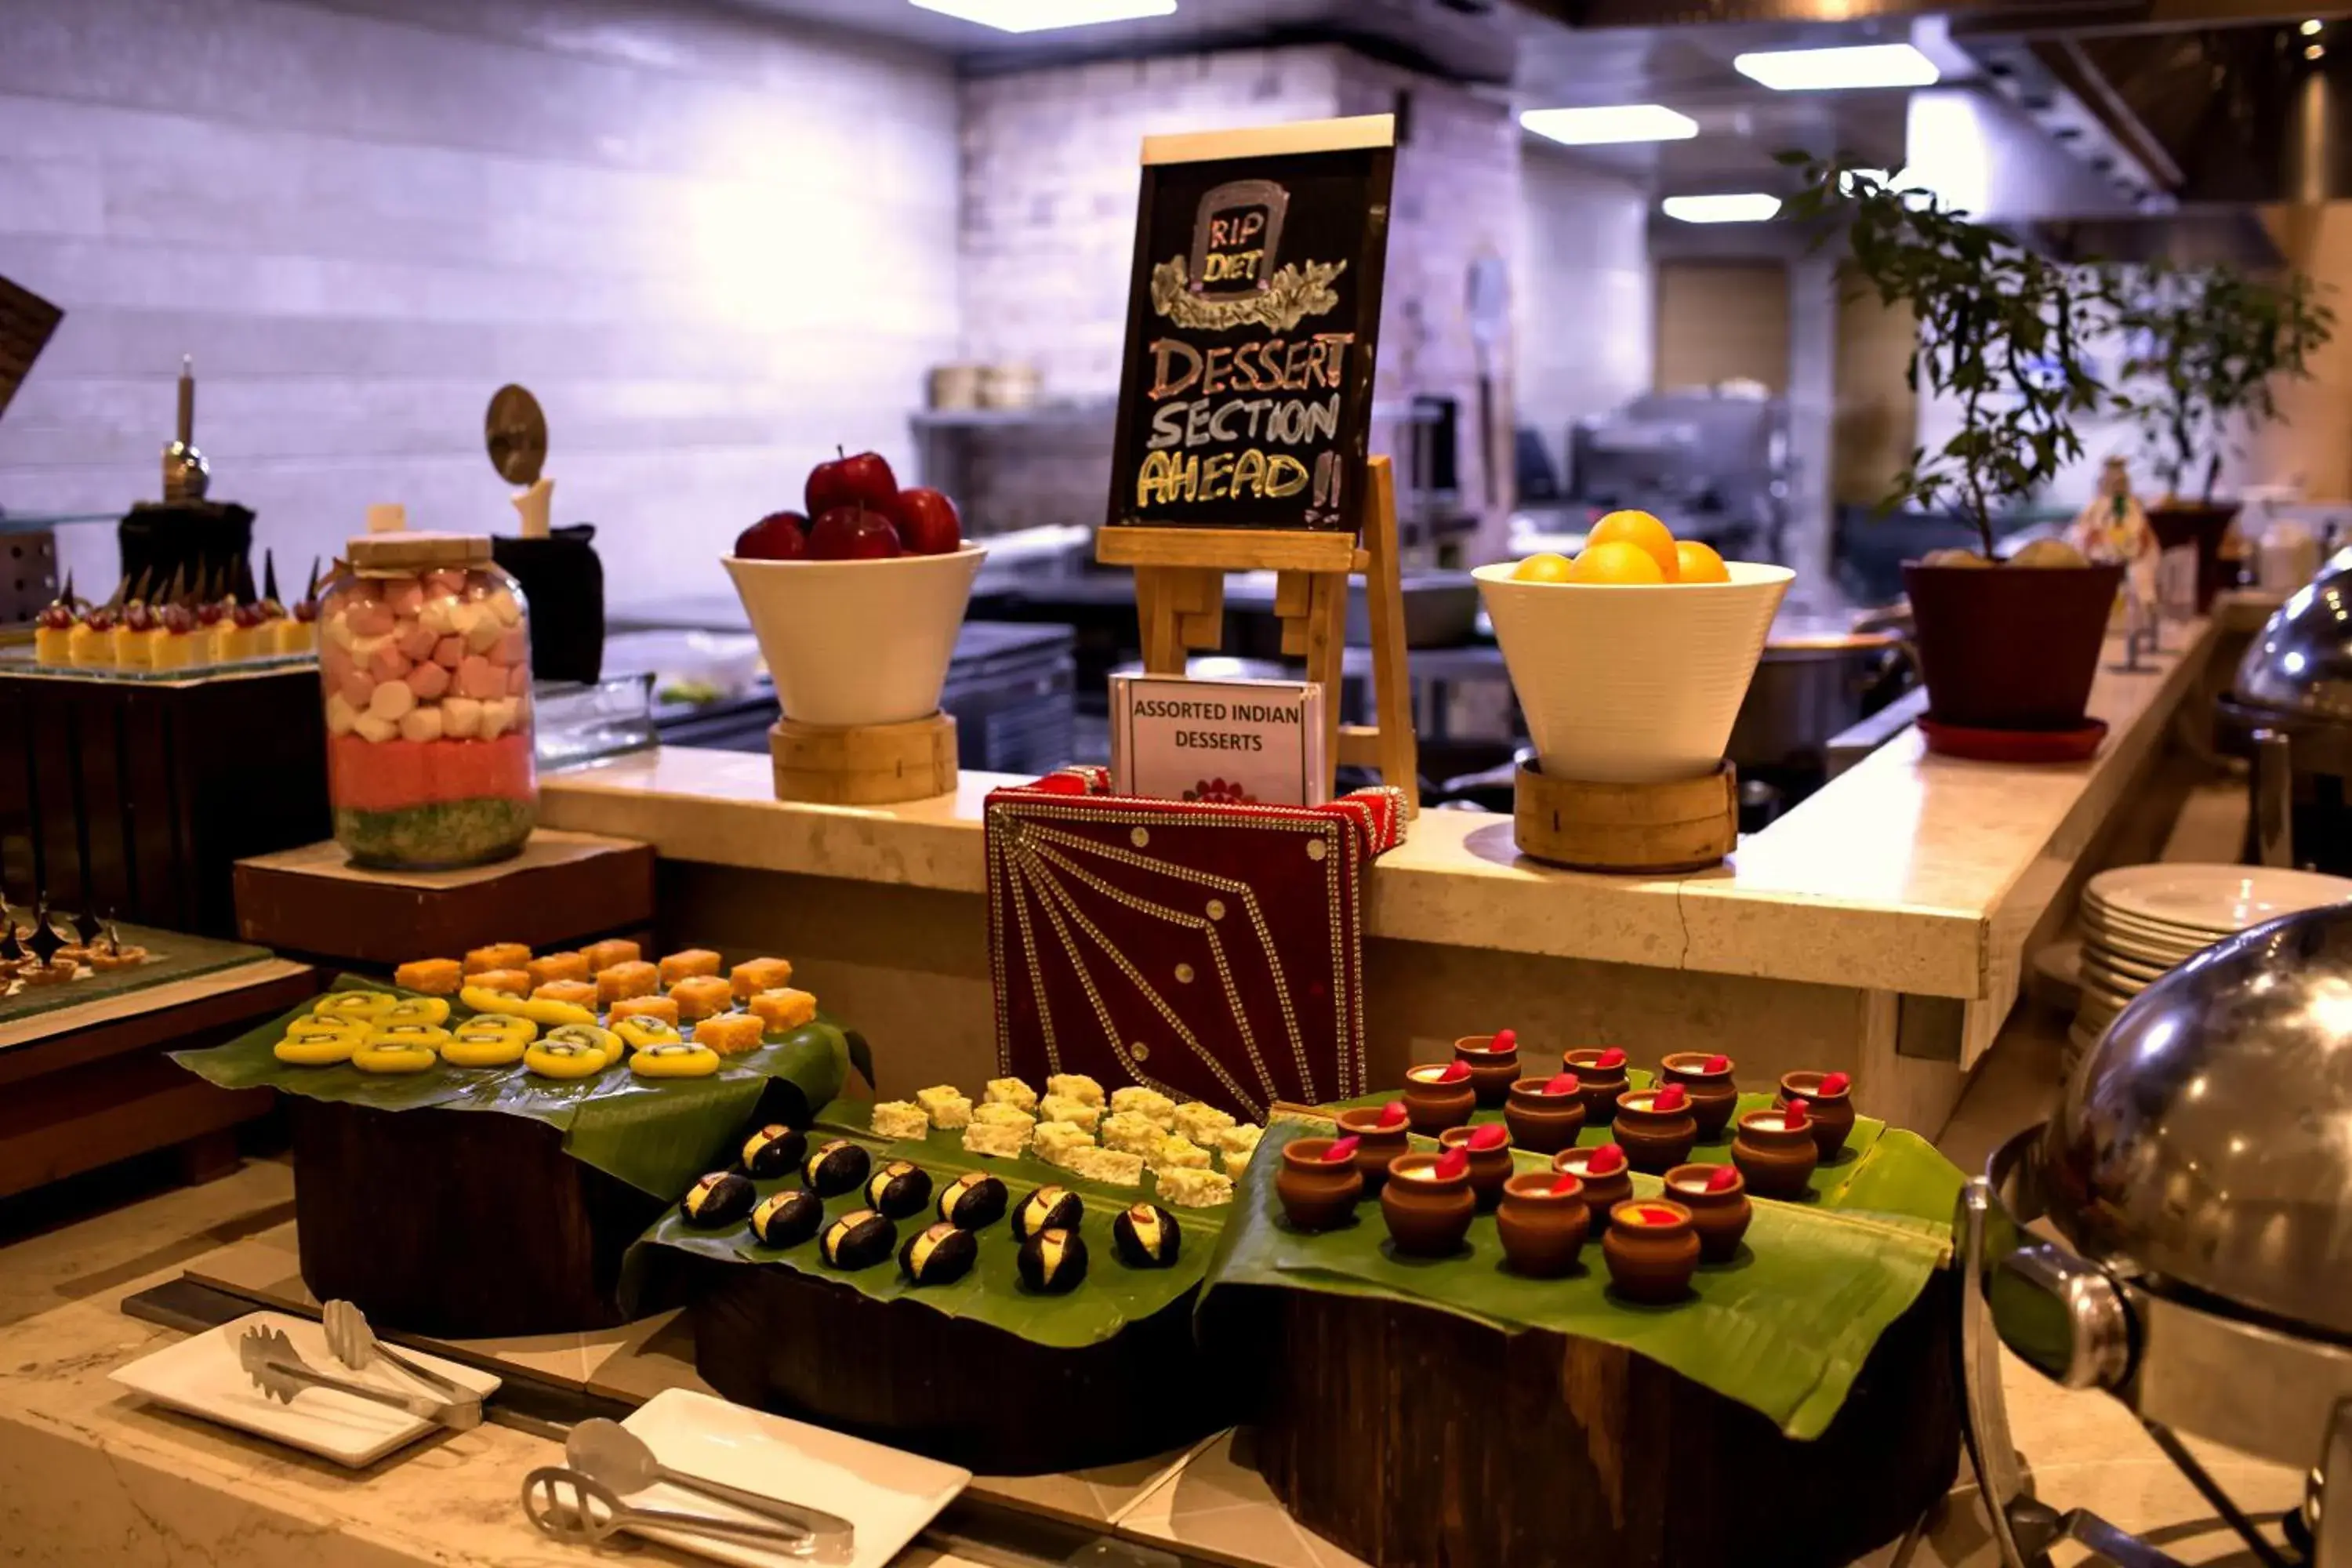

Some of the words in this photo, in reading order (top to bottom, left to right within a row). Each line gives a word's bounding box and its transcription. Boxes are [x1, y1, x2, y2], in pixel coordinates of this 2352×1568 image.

[1210, 212, 1264, 249] RIP
[1202, 249, 1263, 283] DIET
[1148, 332, 1355, 400] DESSERT
[1145, 394, 1340, 449] SECTION
[1134, 700, 1226, 720] ASSORTED
[1232, 705, 1299, 724] INDIAN
[1175, 730, 1263, 752] DESSERTS
